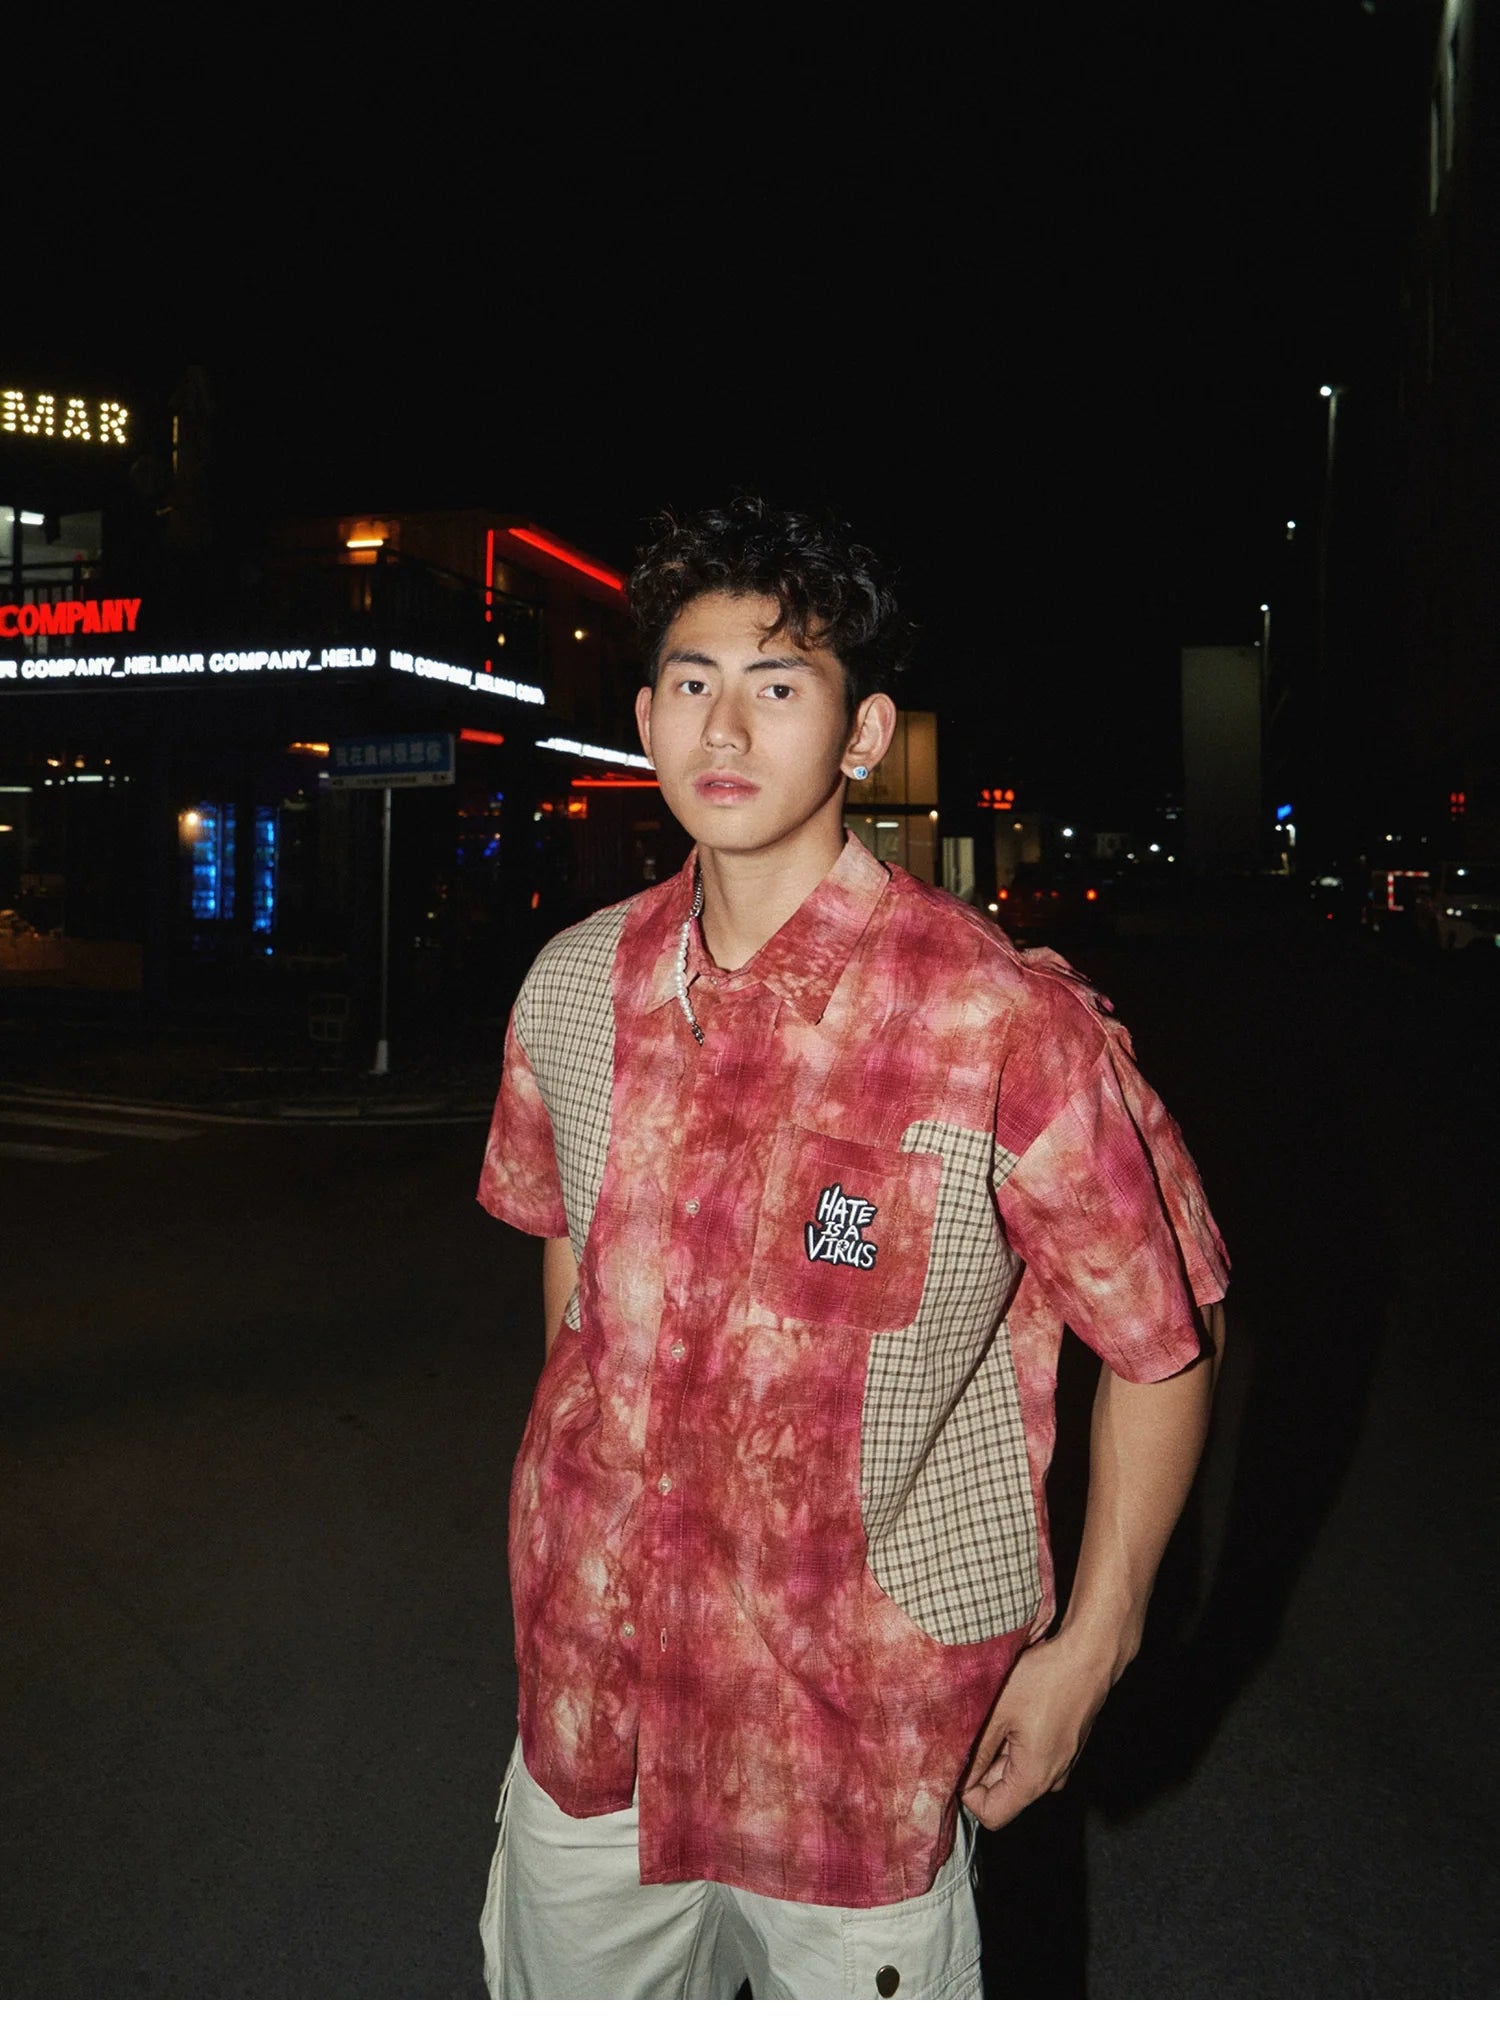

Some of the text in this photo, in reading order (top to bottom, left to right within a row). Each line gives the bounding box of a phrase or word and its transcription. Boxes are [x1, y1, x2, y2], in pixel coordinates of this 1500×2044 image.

[3, 391, 128, 444] MAR
[0, 598, 142, 638] COMPANY
[817, 1184, 877, 1226] HATE
[808, 1224, 877, 1268] VIRUS
[821, 1221, 860, 1241] IS A
